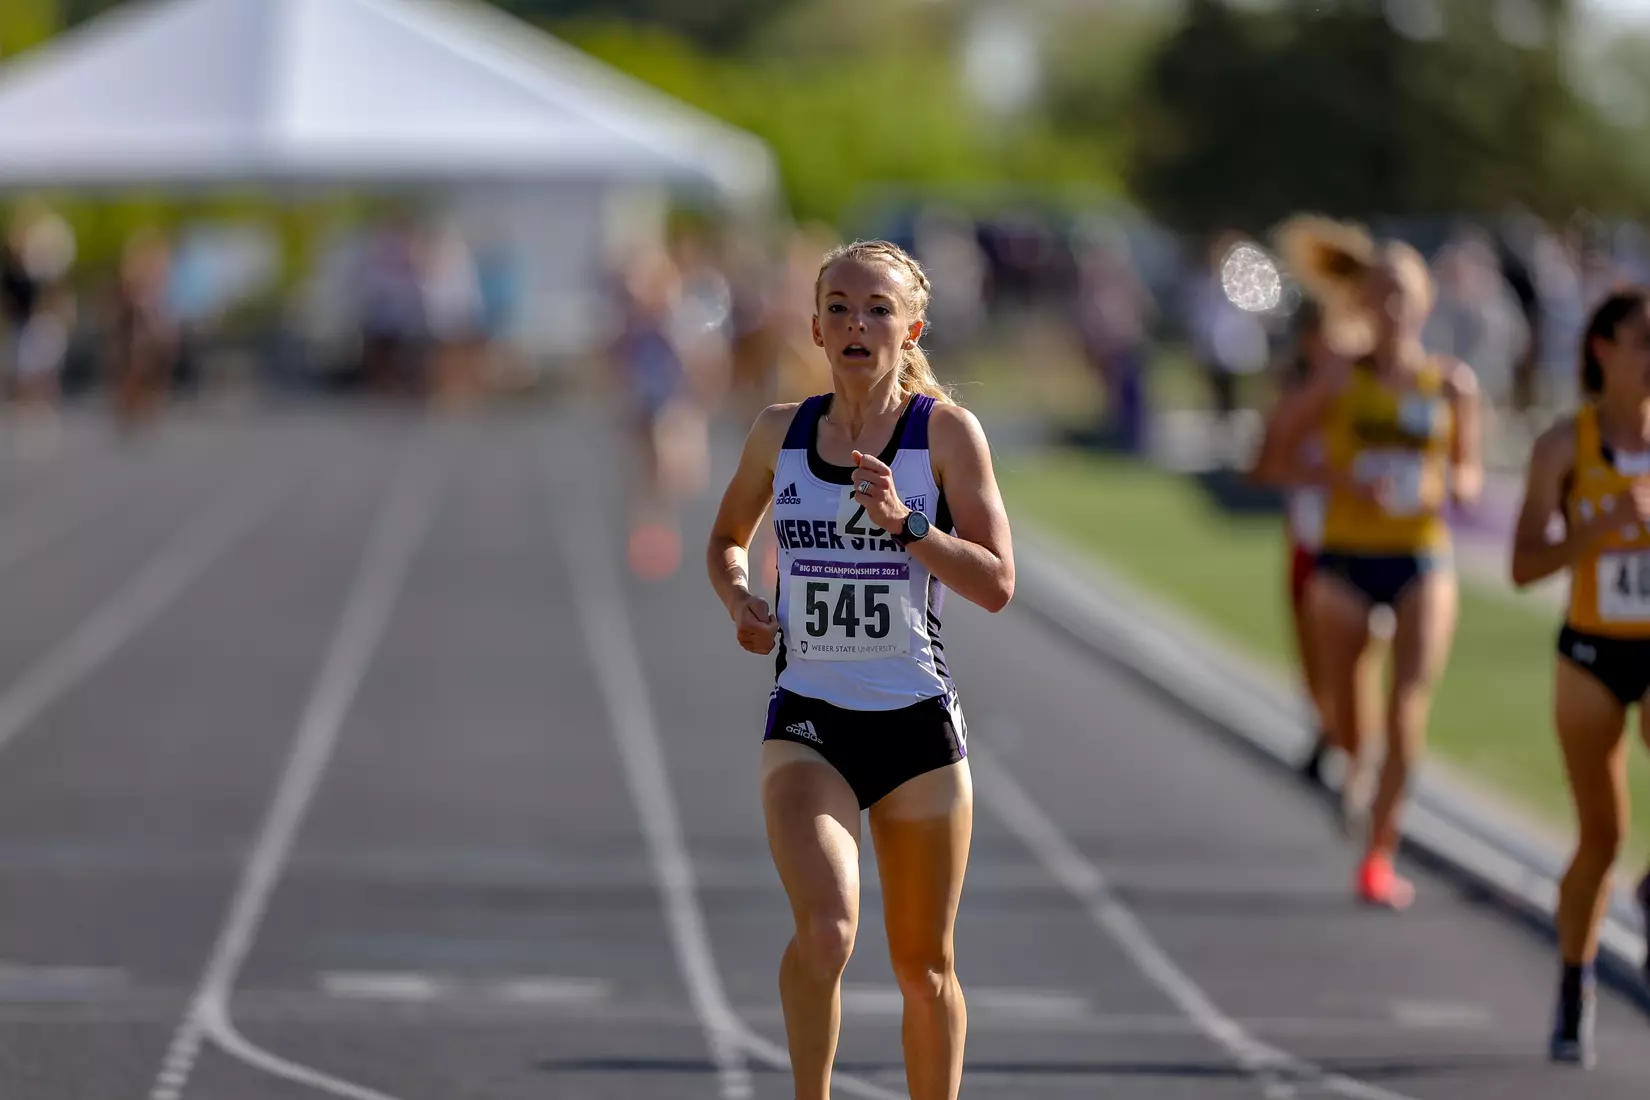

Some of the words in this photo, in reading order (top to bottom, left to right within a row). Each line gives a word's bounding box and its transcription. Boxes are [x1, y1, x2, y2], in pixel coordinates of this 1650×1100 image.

[776, 494, 801, 505] adidas
[904, 497, 925, 511] SKY
[774, 519, 845, 550] WEBER
[799, 564, 811, 572] BIG
[811, 565, 823, 573] SKY
[824, 566, 880, 575] CHAMPIONSHIPS
[882, 568, 899, 576] 2021
[805, 581, 890, 639] 545
[811, 644, 834, 652] WEBER
[835, 645, 856, 653] STATE
[858, 644, 898, 653] UNIVERSITY
[785, 725, 824, 744] adidas
